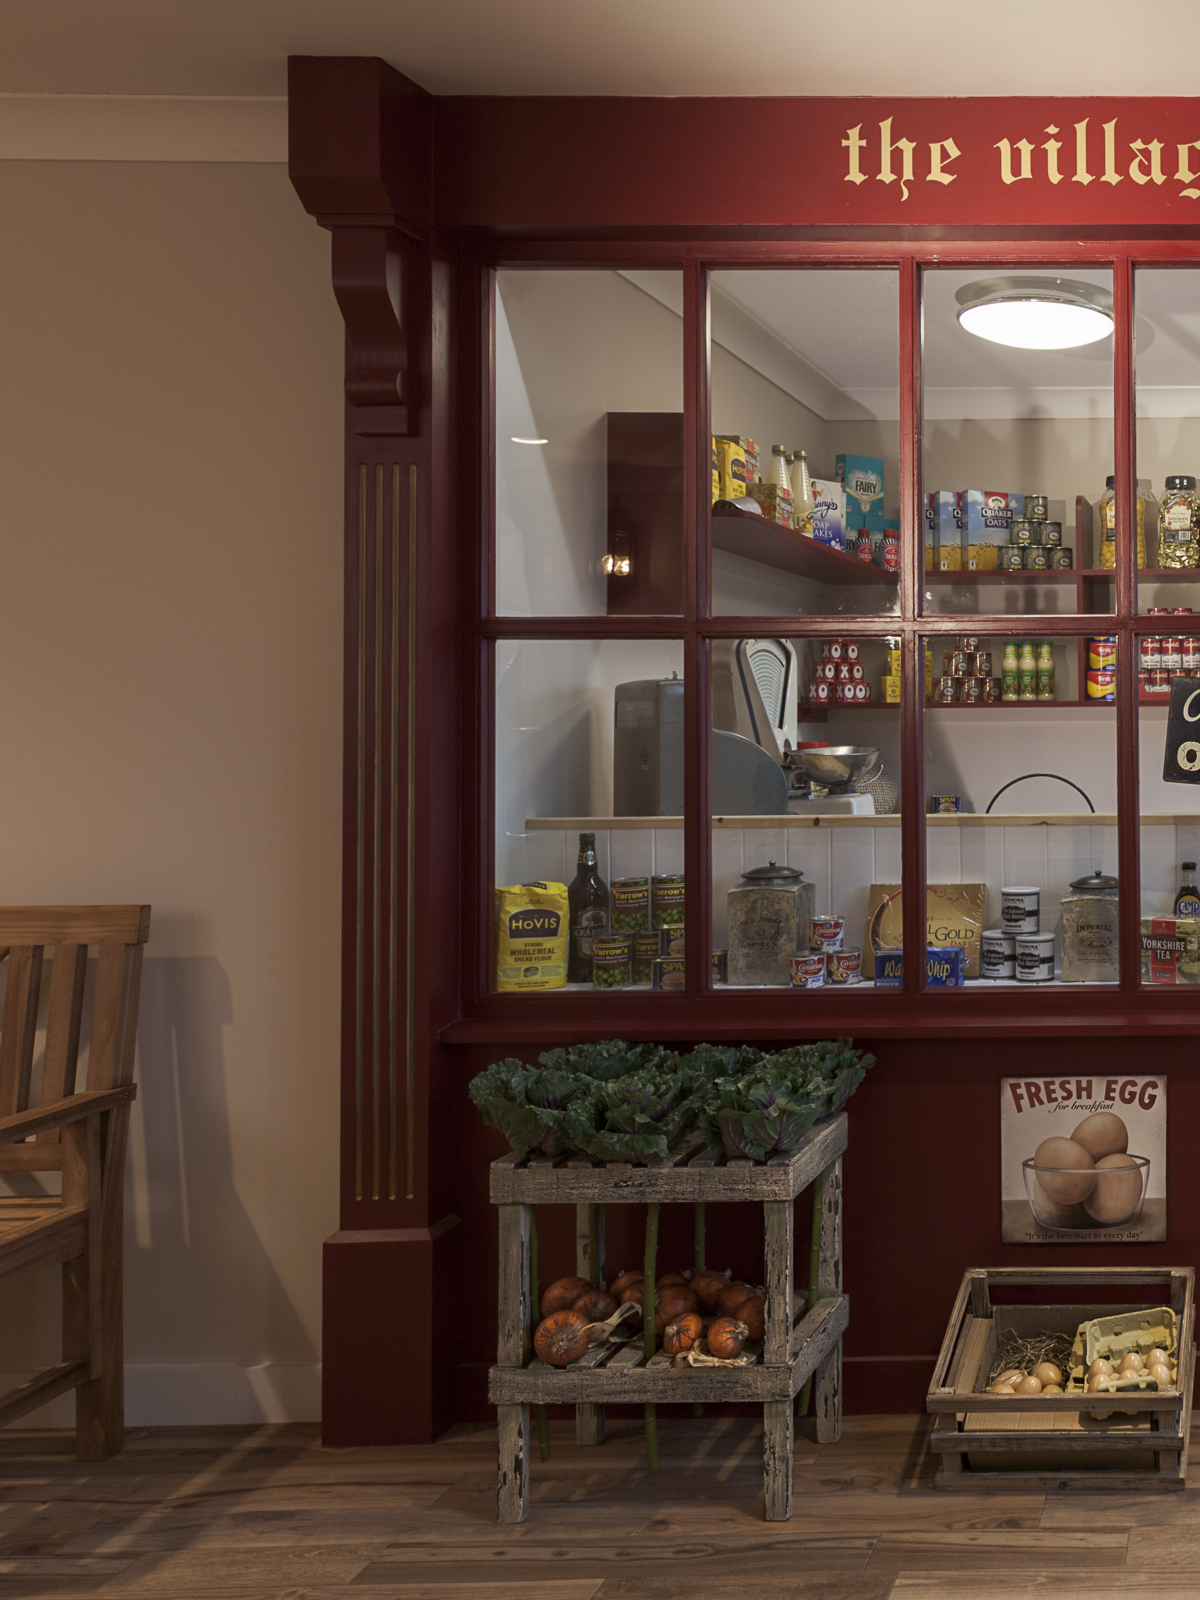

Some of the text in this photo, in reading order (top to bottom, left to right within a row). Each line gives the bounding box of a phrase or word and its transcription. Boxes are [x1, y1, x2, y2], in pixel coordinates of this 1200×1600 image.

[841, 116, 962, 202] the
[855, 480, 877, 494] FAIRY
[813, 499, 838, 518] anny's
[982, 508, 1012, 518] QUAKER
[813, 521, 830, 530] OAP
[986, 519, 1007, 527] OATS
[814, 529, 833, 538] AKES
[615, 890, 648, 899] Farrow's
[1178, 900, 1200, 914] CAMP
[740, 917, 783, 927] OLD JUDGE
[934, 926, 975, 941] GOLD
[1076, 924, 1113, 933] IMPERIAL
[1142, 937, 1186, 951] YORKSHIRE
[510, 947, 556, 956] WHOLEMEAL
[594, 947, 629, 955] Farrow's
[1156, 950, 1171, 960] TEA
[662, 962, 685, 972] SPA
[1009, 1079, 1159, 1114] FRESH EGG
[1048, 1100, 1115, 1113] for breakfast
[1042, 1232, 1055, 1240] the
[1056, 1232, 1072, 1240] best
[1073, 1232, 1092, 1240] start
[1103, 1232, 1125, 1242] every
